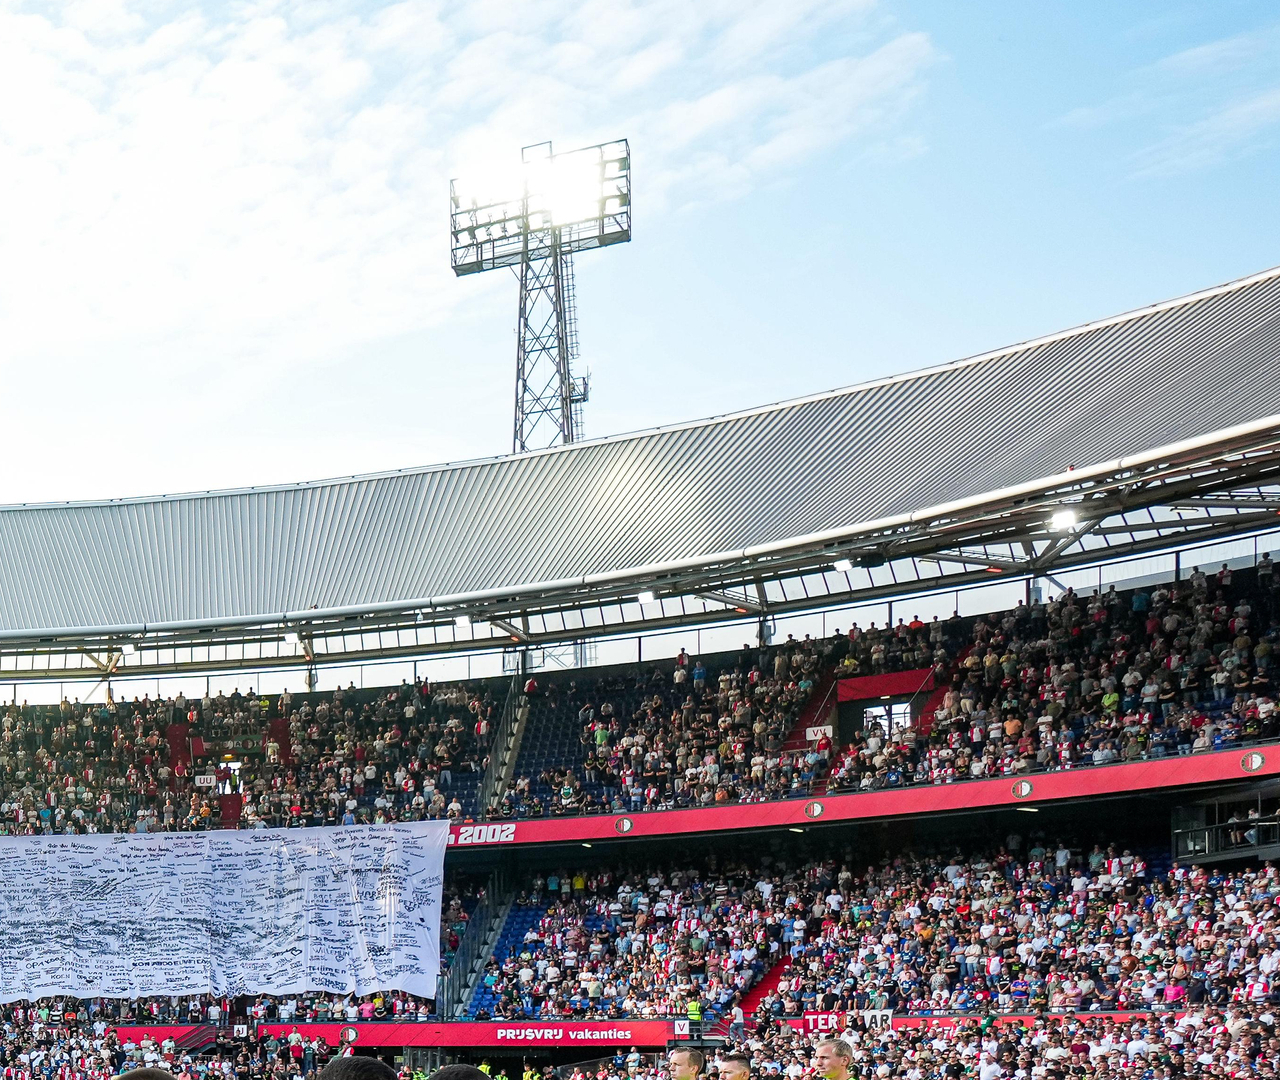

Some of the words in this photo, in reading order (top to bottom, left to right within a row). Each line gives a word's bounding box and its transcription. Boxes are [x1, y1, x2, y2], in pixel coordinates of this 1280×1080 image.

[458, 824, 516, 844] 2002
[678, 1023, 686, 1032] V
[808, 1016, 838, 1029] TER
[569, 1028, 632, 1040] vakanties
